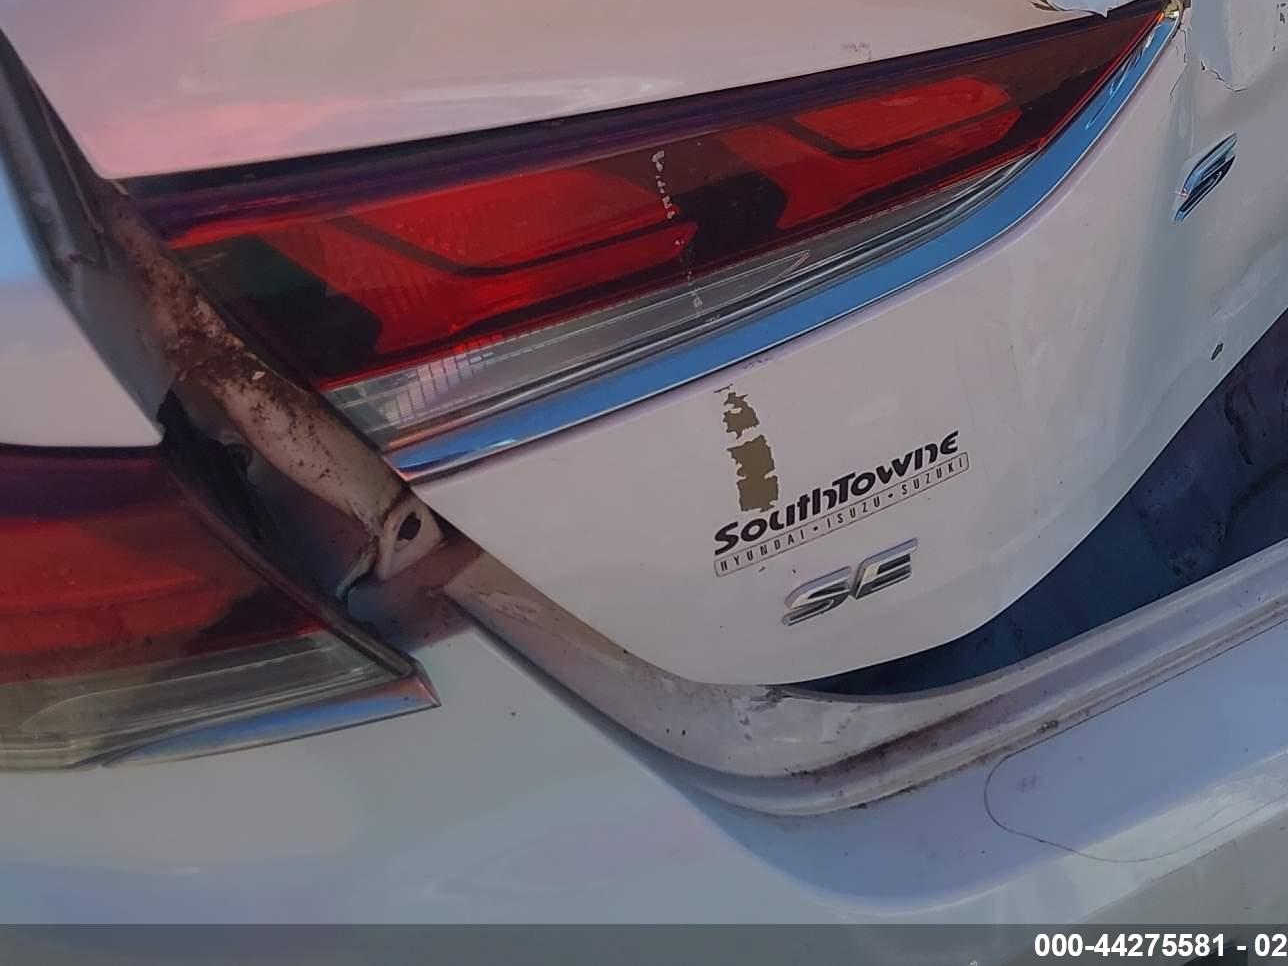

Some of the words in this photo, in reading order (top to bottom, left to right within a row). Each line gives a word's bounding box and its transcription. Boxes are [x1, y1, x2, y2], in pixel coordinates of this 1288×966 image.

[720, 530, 804, 572] HYUNDAI
[826, 497, 881, 528] ISUZU
[902, 458, 963, 495] SUZUKI
[783, 538, 918, 626] SE
